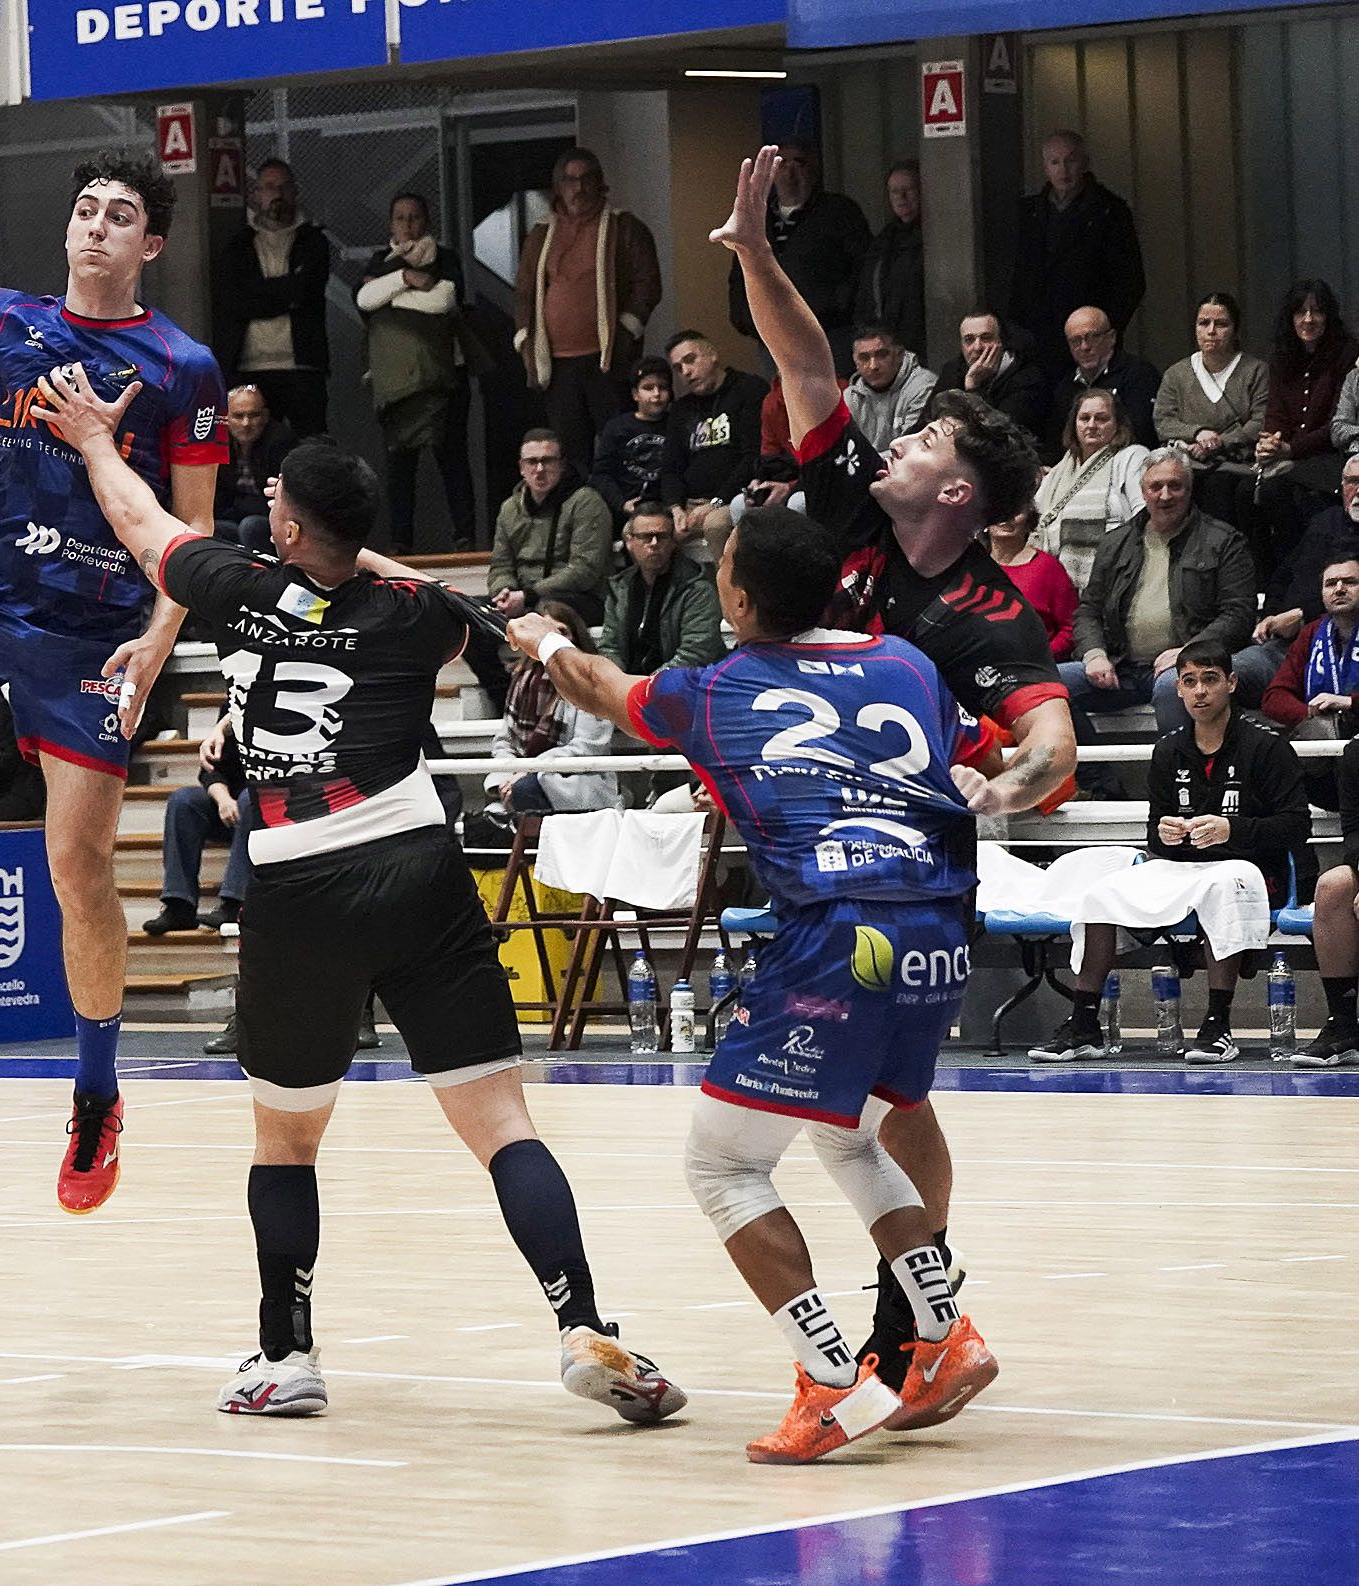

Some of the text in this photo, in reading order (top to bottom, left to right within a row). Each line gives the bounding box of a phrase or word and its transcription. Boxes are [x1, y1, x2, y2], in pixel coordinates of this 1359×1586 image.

[929, 79, 958, 115] A
[164, 120, 188, 154] A
[219, 649, 355, 755] 13
[751, 687, 942, 792] 22
[851, 849, 875, 867] DE
[904, 1249, 962, 1323] ELITE
[788, 1293, 852, 1368] ELITE
